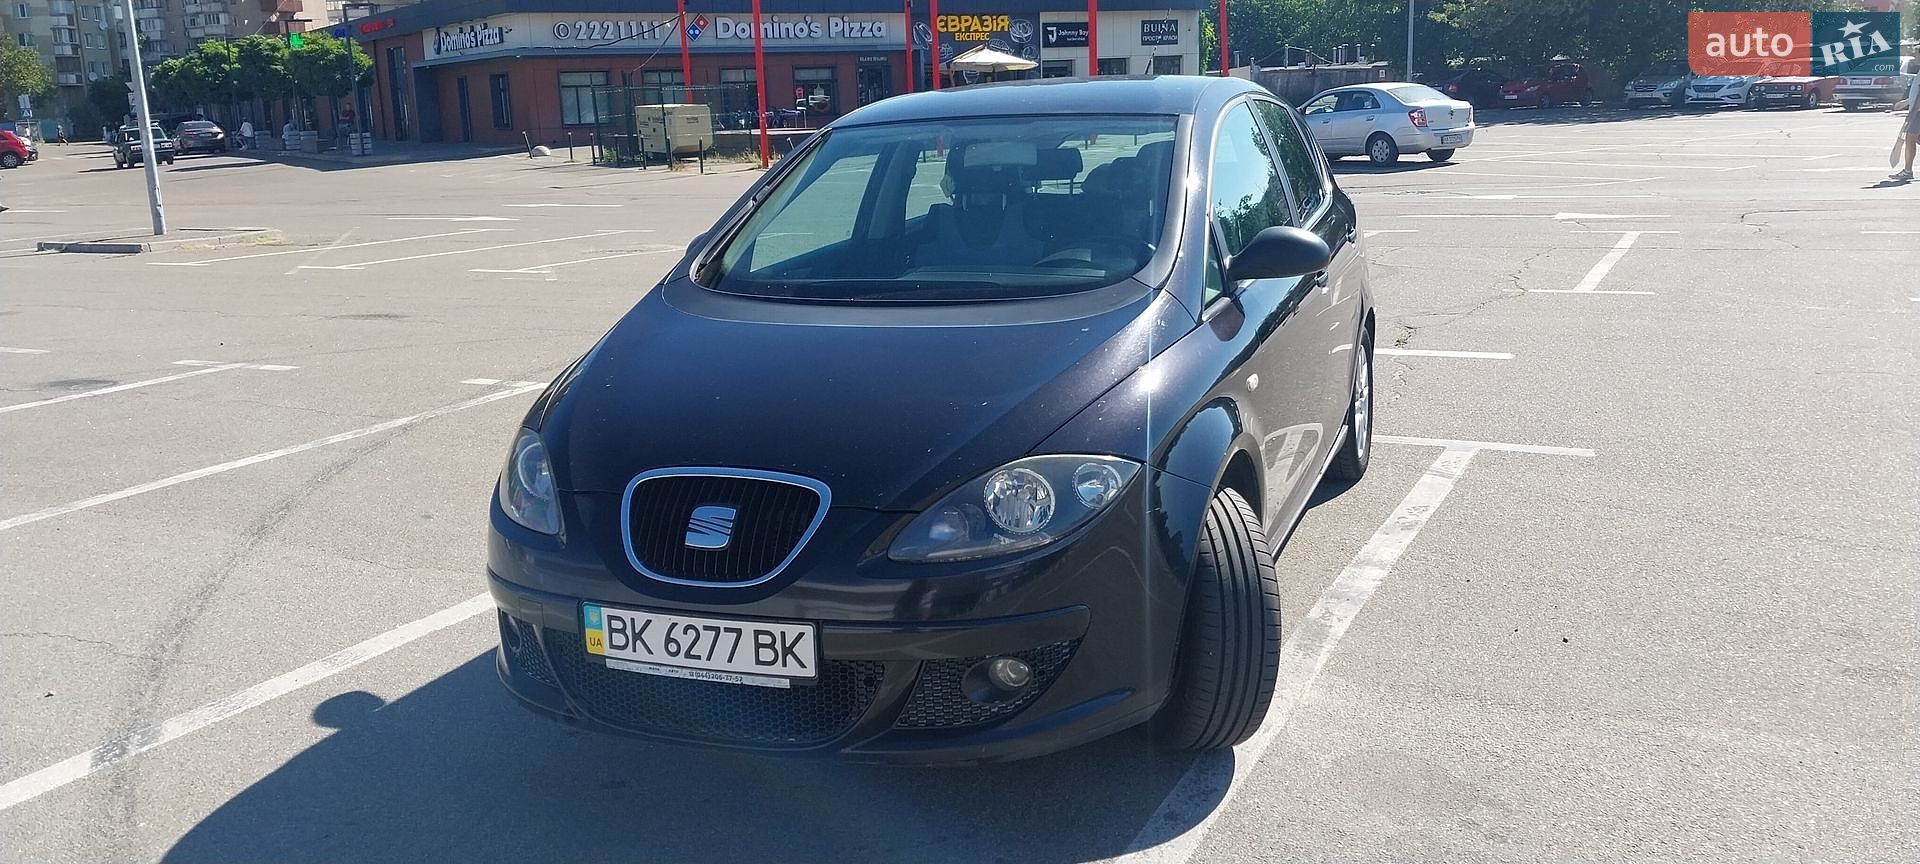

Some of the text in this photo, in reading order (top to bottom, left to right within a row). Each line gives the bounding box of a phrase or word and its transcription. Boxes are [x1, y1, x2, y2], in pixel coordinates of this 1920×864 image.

[477, 24, 500, 47] Pizza
[574, 20, 660, 41] 2221111
[715, 15, 887, 39] Domino's Pizza
[954, 32, 990, 41] ЕКСПРЕС
[589, 636, 603, 649] UA
[606, 614, 808, 669] BK 6277 BK
